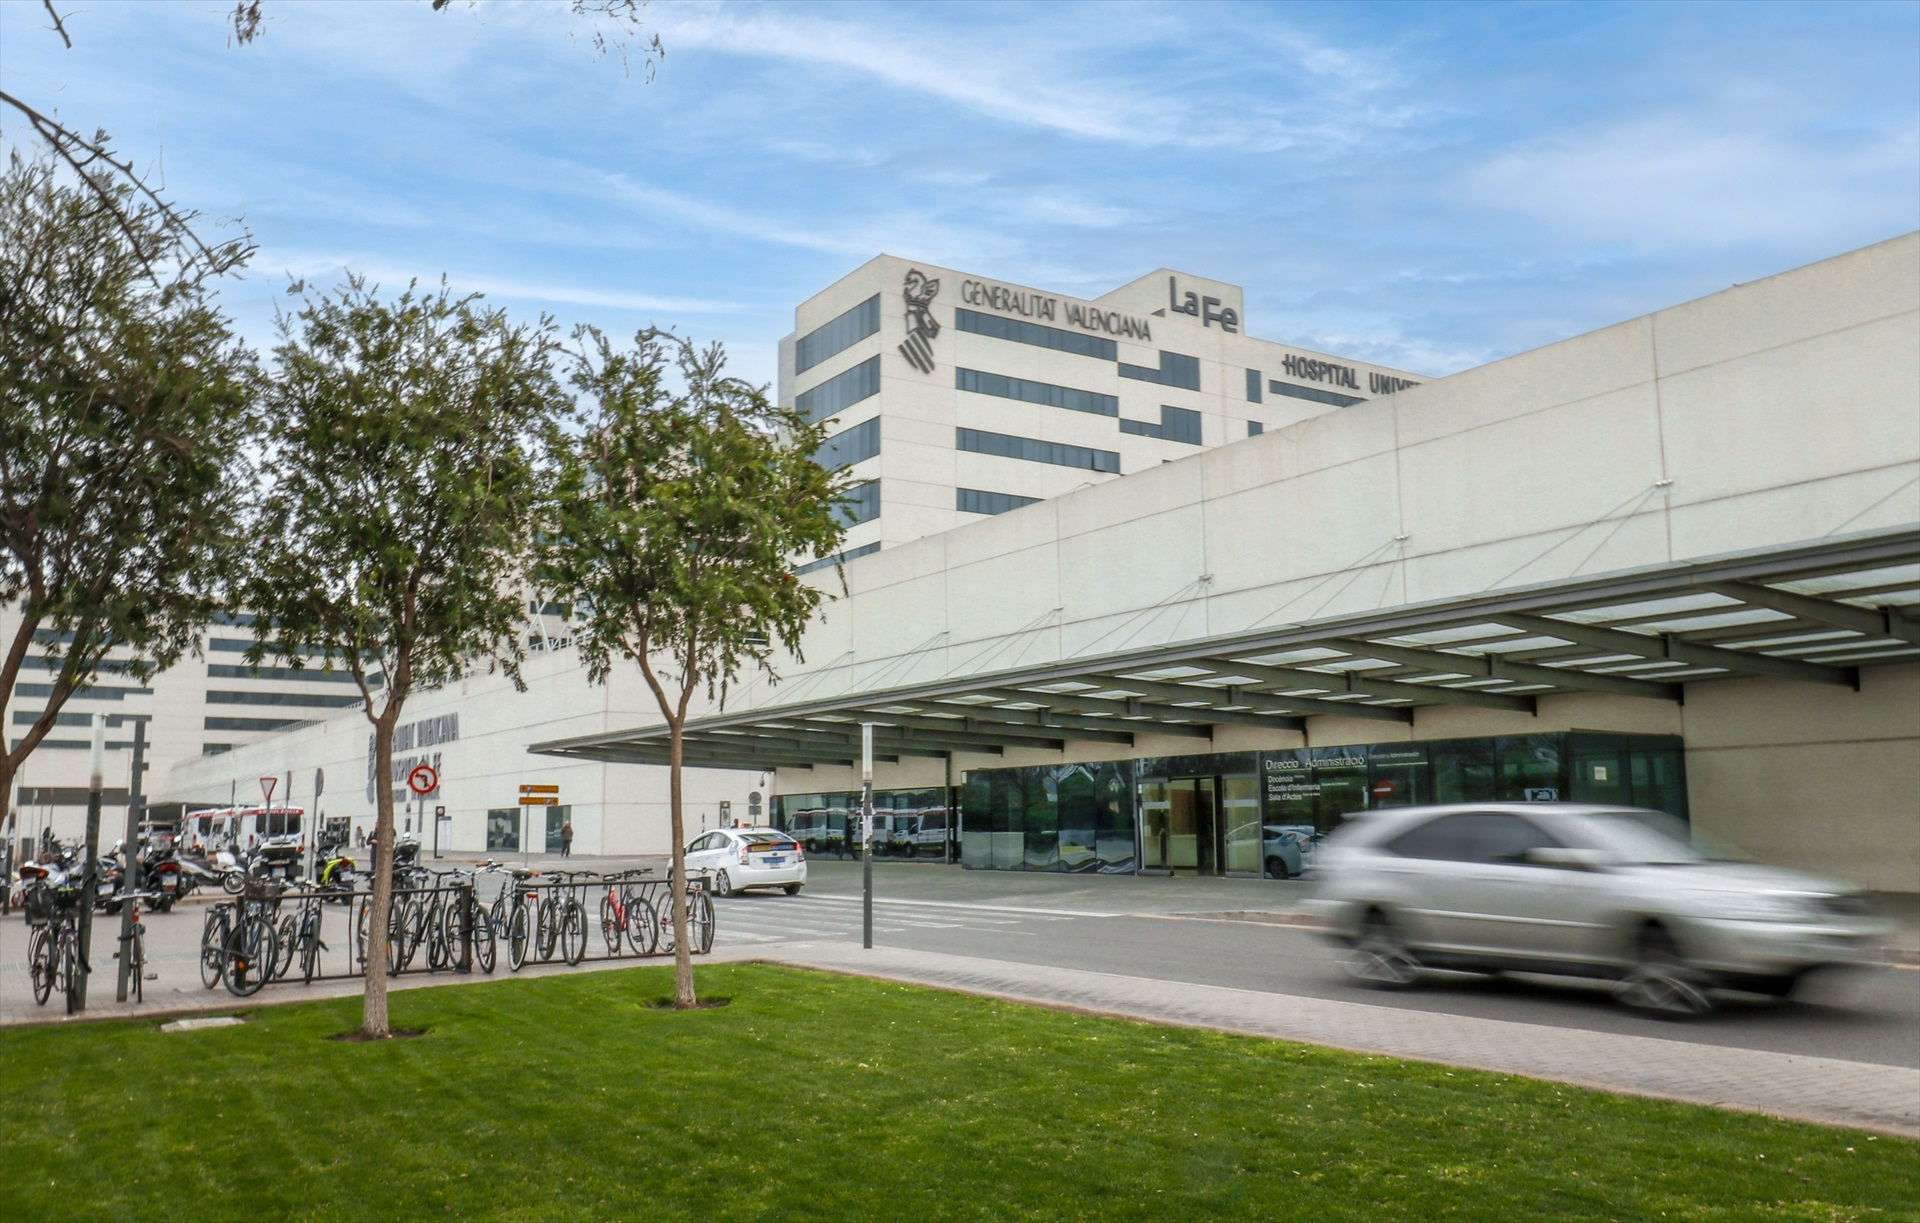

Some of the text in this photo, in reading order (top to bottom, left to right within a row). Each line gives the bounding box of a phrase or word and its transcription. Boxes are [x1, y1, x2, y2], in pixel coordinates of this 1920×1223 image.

[961, 279, 1151, 342] GENERALITAT VALENCIANA
[1281, 353, 1422, 395] HOSPITAL UNIV
